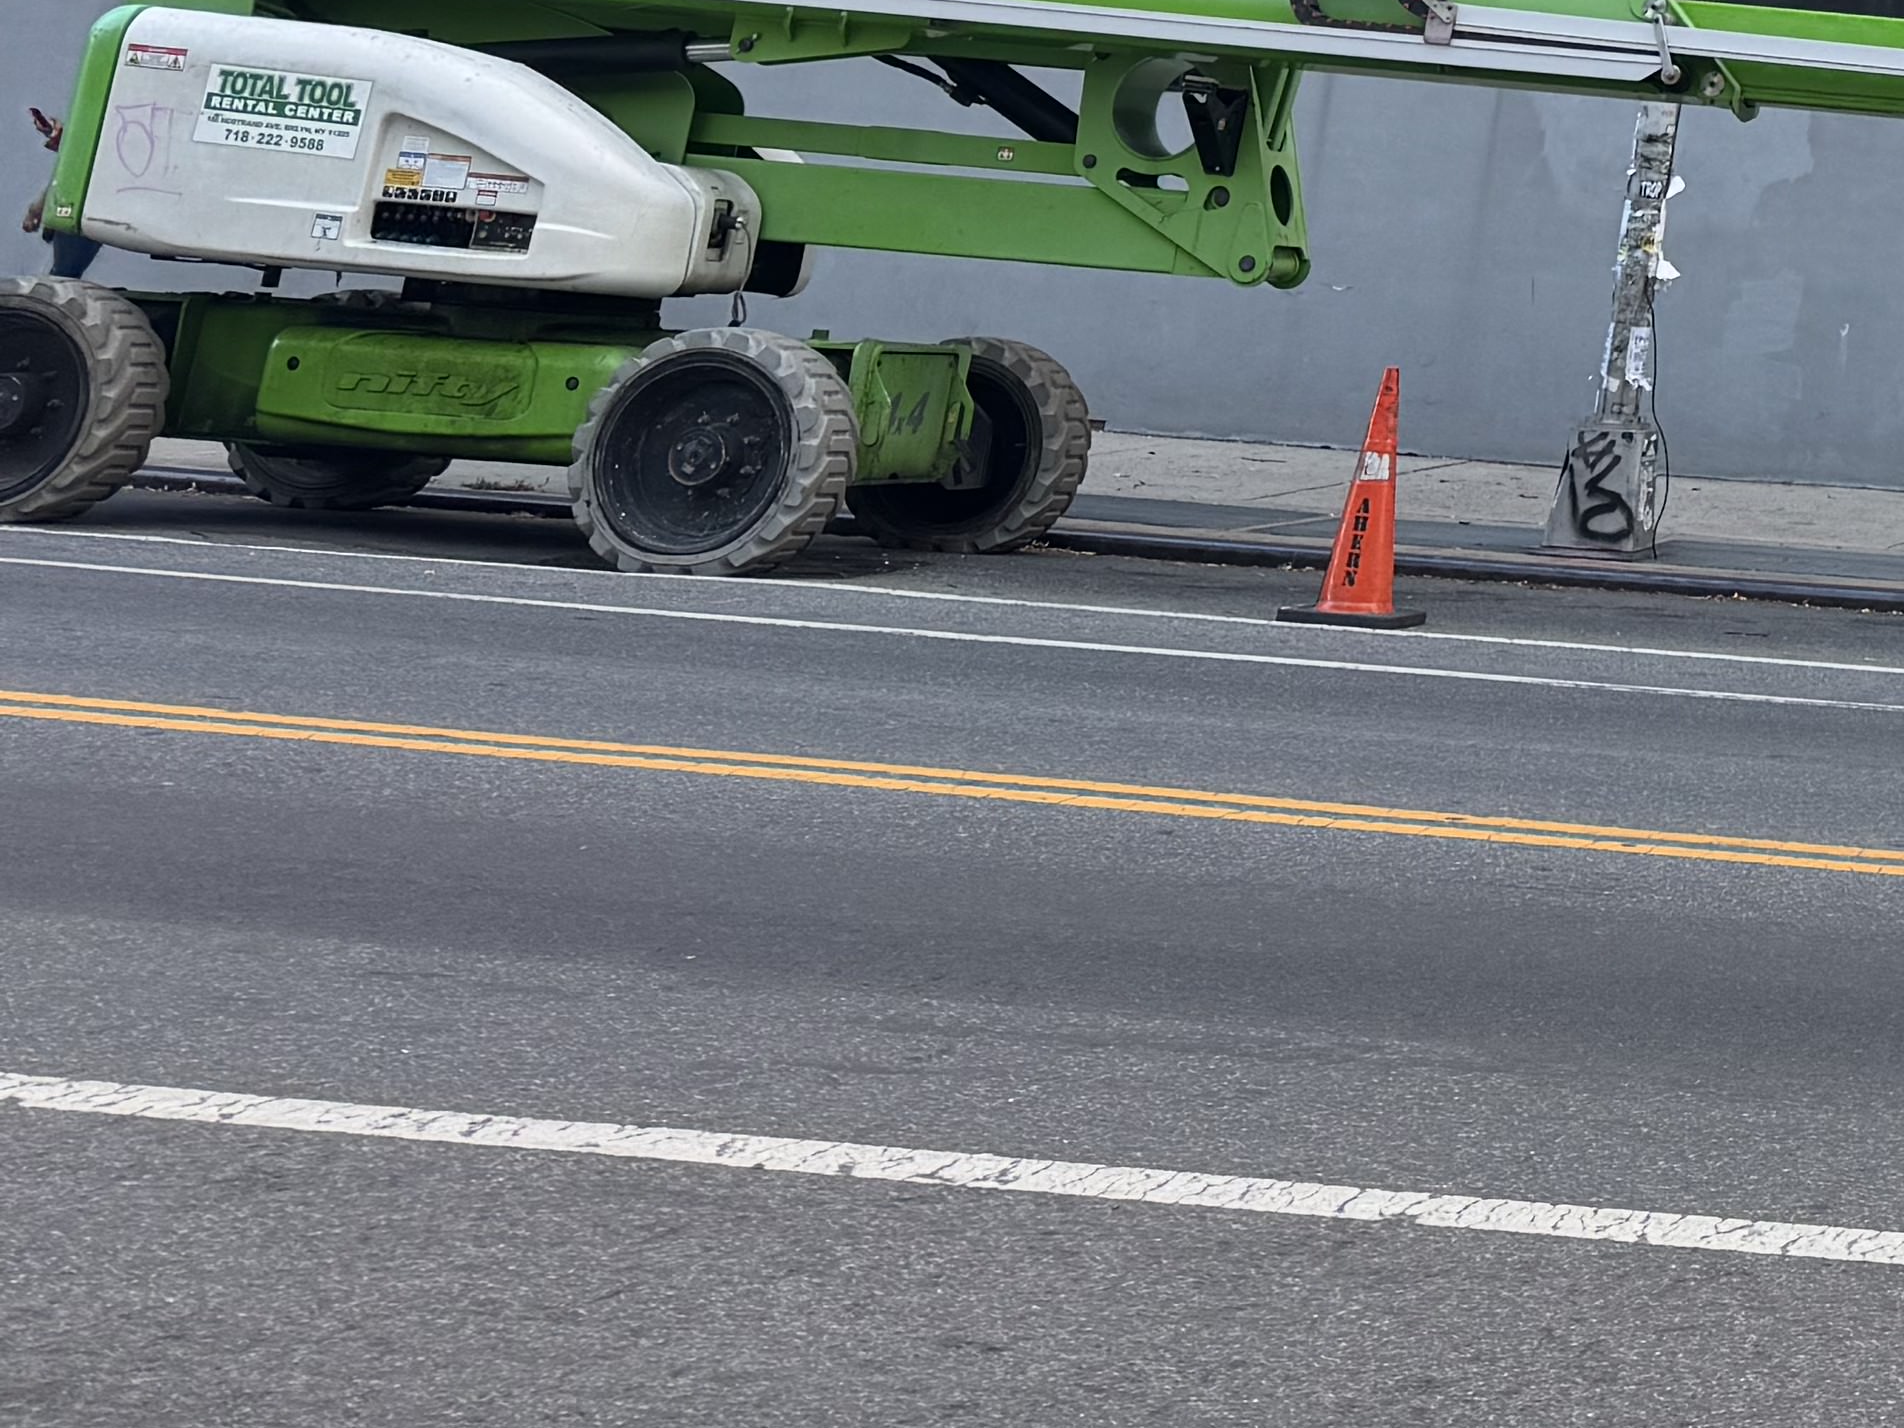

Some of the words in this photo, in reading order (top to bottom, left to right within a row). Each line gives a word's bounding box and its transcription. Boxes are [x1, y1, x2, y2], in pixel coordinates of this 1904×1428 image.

[219, 69, 289, 100] TOTAL
[295, 77, 358, 108] TOOL
[211, 96, 277, 114] RENTAL
[284, 104, 354, 123] CENTER
